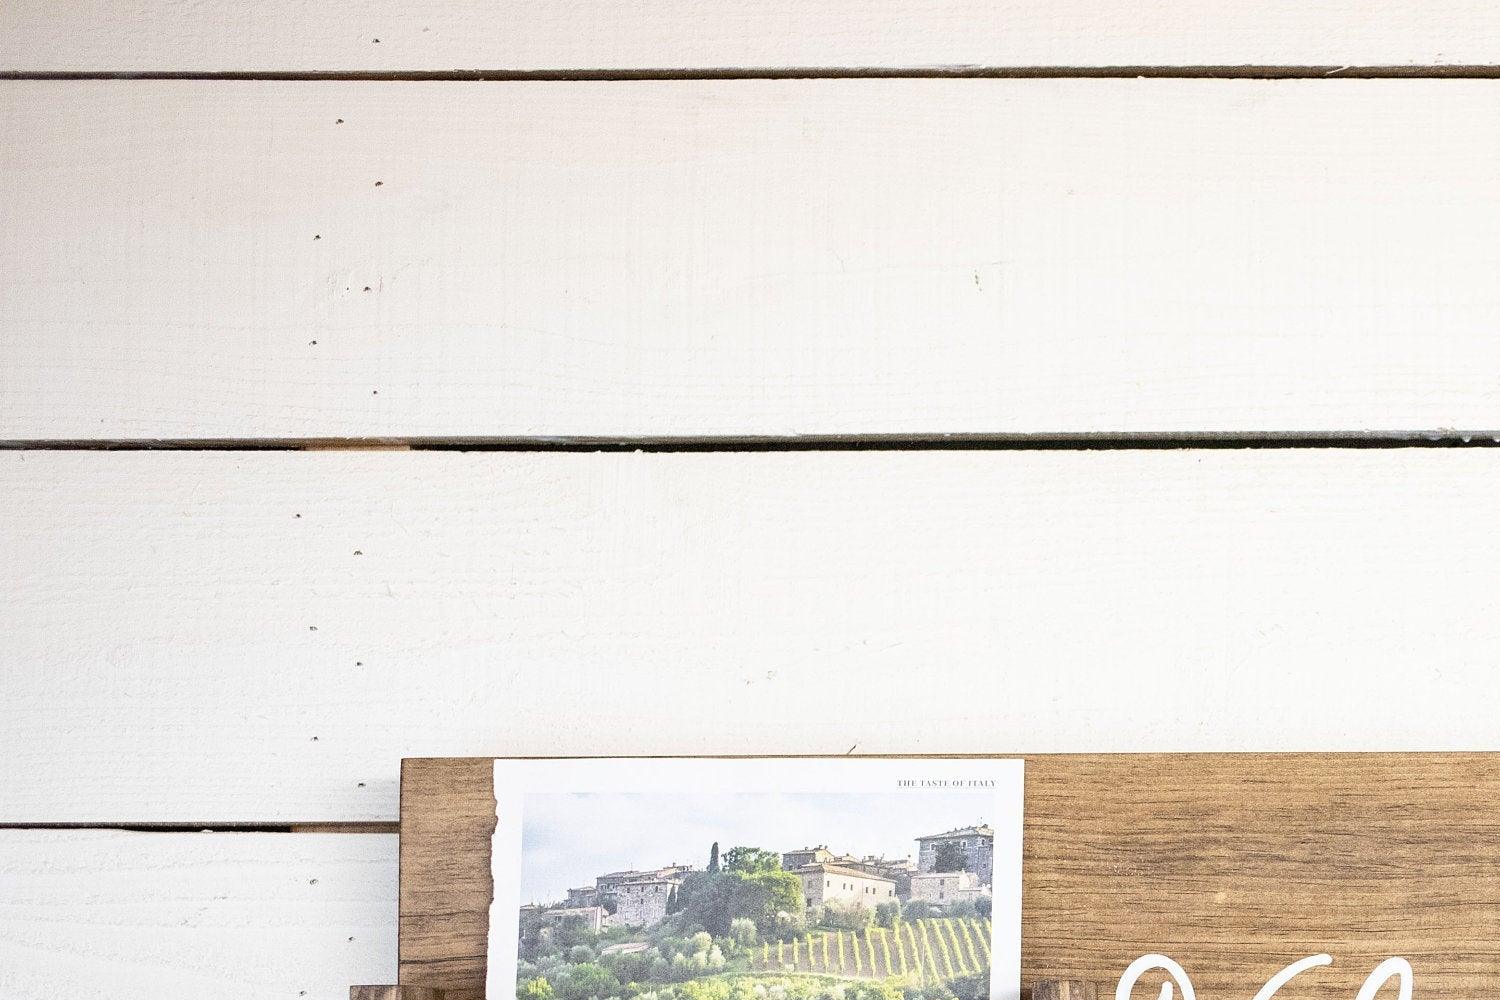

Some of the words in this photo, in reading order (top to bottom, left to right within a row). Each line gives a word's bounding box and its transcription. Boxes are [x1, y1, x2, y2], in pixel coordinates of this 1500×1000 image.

[897, 779, 917, 787] THE
[920, 779, 948, 787] TASTE
[952, 779, 965, 787] OF
[968, 779, 997, 787] ITALY
